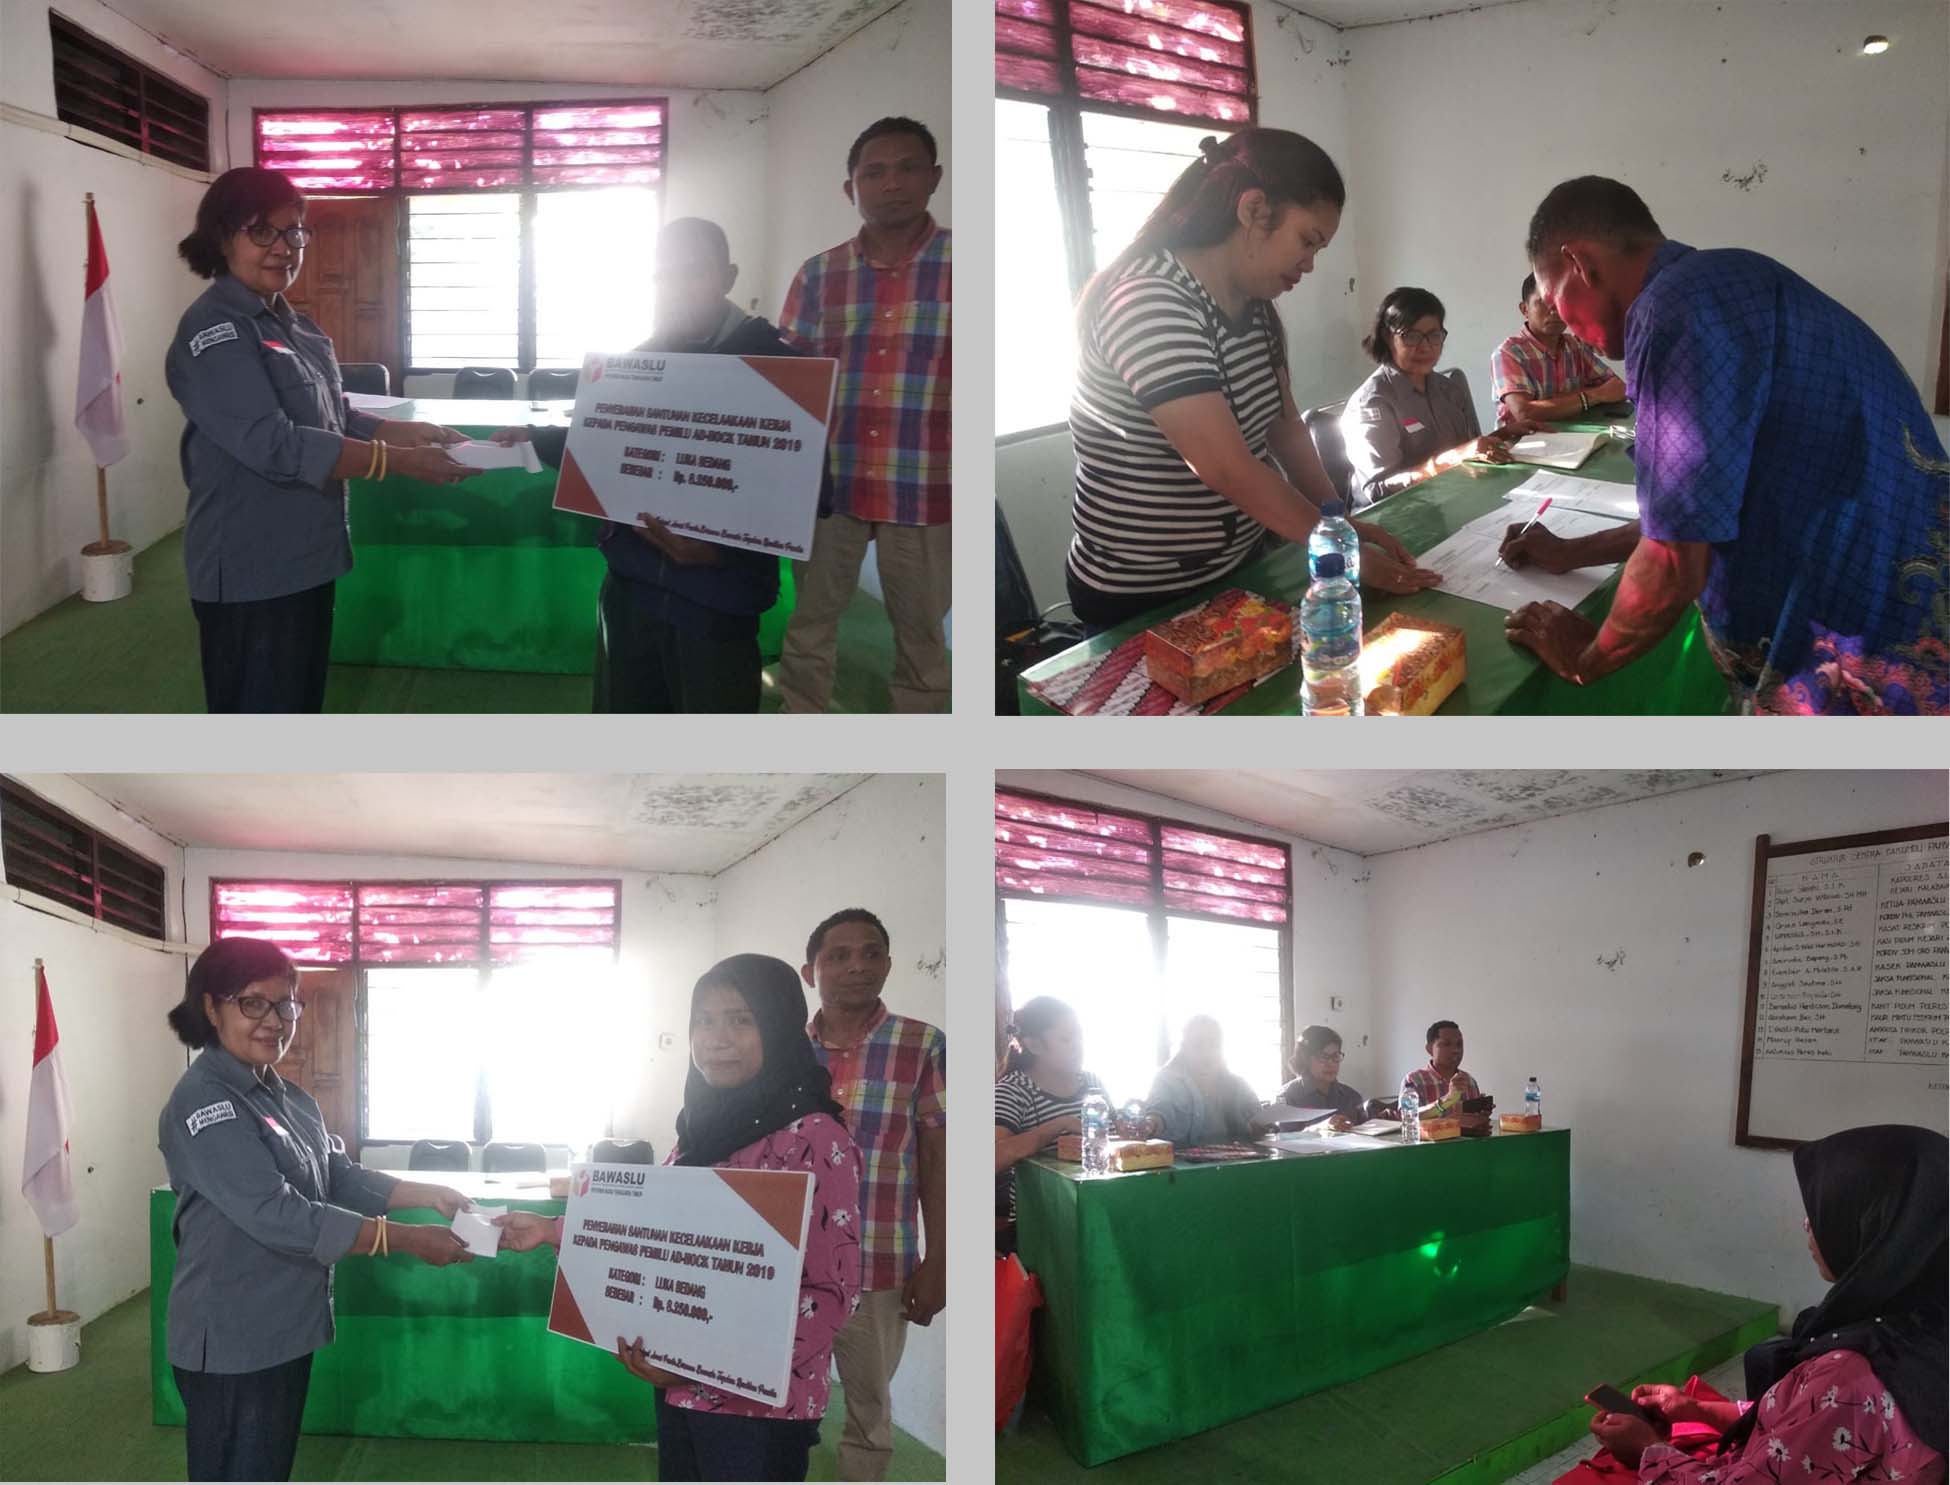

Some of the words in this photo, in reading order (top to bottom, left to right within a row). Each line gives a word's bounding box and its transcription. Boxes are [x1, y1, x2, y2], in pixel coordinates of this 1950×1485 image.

[607, 357, 666, 371] BAWASLU
[759, 417, 792, 433] KERJA
[584, 417, 612, 431] KEPADA
[614, 420, 657, 436] PENGAWAS
[658, 425, 691, 440] PEMILU
[736, 433, 770, 449] TAHUN
[772, 438, 803, 453] 2019
[676, 452, 697, 467] LUKA
[196, 1103, 232, 1118] BAWASLU
[591, 1169, 646, 1186] BAWASLU
[583, 1218, 627, 1237] PENYERAHAN
[628, 1224, 668, 1243] SANTUNAN
[732, 1238, 765, 1258] KERJA
[573, 1234, 599, 1249] KEPADA
[599, 1238, 639, 1258] PENGAWAS
[639, 1246, 669, 1261] PEMILU
[712, 1256, 744, 1276] TAHUN
[746, 1263, 776, 1281] 2019
[608, 1267, 641, 1286] KATEGORI
[655, 1276, 675, 1292] LUKA
